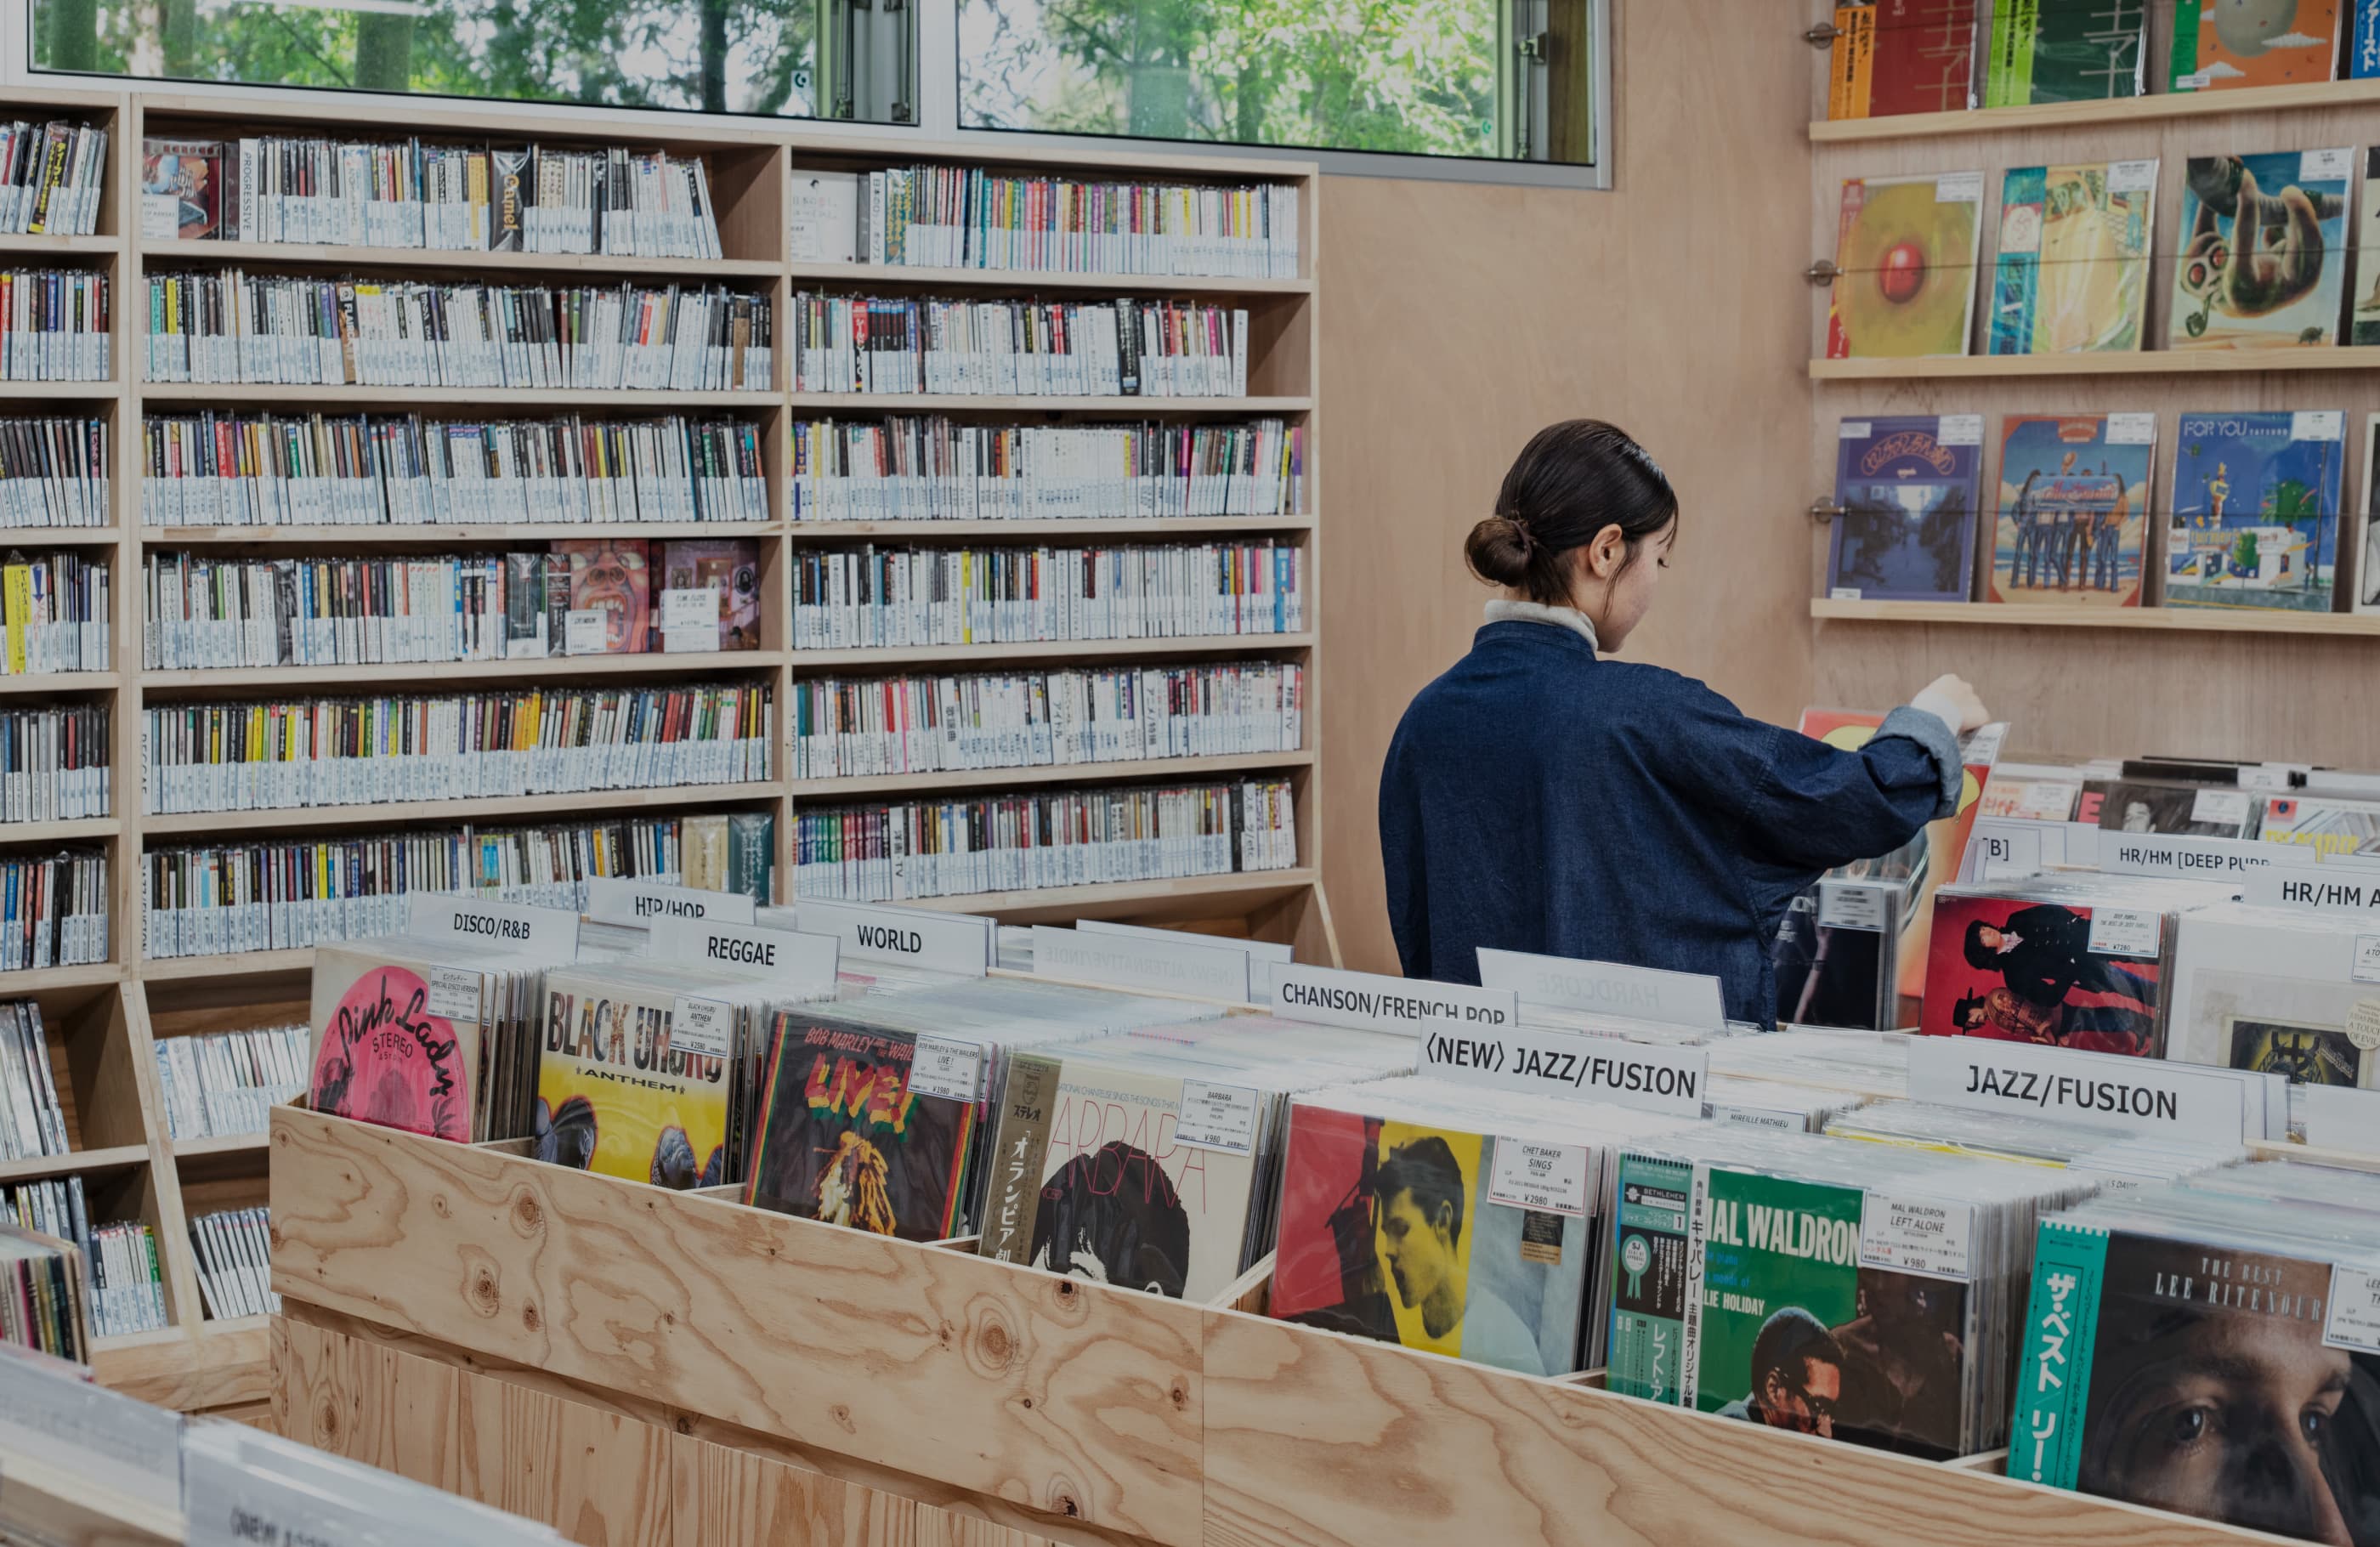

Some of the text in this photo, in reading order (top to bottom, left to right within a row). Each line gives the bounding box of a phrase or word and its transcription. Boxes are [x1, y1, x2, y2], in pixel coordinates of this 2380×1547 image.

[243, 151, 252, 231] PROGRESSIVE
[502, 174, 520, 231] Camel
[2184, 421, 2215, 436] FOR
[2217, 421, 2248, 436] YOU
[1053, 701, 1062, 740] アイドル
[2120, 847, 2173, 865] HR/HM
[2178, 852, 2224, 870] [DEEP
[2282, 881, 2361, 907] HR/HM
[453, 913, 530, 939] DISCO/R&B
[857, 924, 922, 954] WORLD
[707, 936, 775, 966] REGGAE
[1282, 982, 1459, 1021] CHANSON/FRENCH
[546, 990, 631, 1066] BLACK
[690, 1012, 711, 1023] ANTHEM
[338, 974, 456, 1096] Pink Lady
[372, 1032, 413, 1058] STEREO
[804, 1026, 830, 1046] BOB
[830, 1031, 875, 1054] MARLEY
[887, 1043, 916, 1062] WAIL
[584, 1068, 677, 1093] ANTHEM
[1511, 1046, 1697, 1099] JAZZ/FUSION
[804, 1051, 921, 1143] LIVE!
[1207, 1091, 1232, 1102] BARBARA
[1966, 1064, 2178, 1120] JAZZ/FUSION
[1012, 1104, 1042, 1122] ステレオ
[1730, 1114, 1789, 1128] MIREILLE MATHIEU
[1204, 1133, 1221, 1143] ¥980
[1044, 1096, 1207, 1216] ARBARA
[1522, 1145, 1561, 1159] CHET BAKER
[1528, 1158, 1552, 1170] SINGS
[1524, 1193, 1548, 1205] ¥2980
[1643, 1188, 1685, 1200] BETHLEHEM
[1890, 1203, 1946, 1219] MAL WALDRON
[1890, 1216, 1946, 1232] LEFT ALONE
[1632, 1242, 1640, 1250] SJ
[1748, 1203, 1862, 1267] WALDRON
[1689, 1219, 1703, 1299] キャバレー
[1903, 1257, 1926, 1269] ¥980
[2202, 1257, 2283, 1286] THE BEST
[1703, 1289, 1765, 1316] LIE HOLIDAY
[2155, 1272, 2322, 1322] LEE RITENOUR
[2037, 1272, 2077, 1392] ザ・ベスト
[1683, 1302, 1698, 1408] 主題曲オリジナル盤
